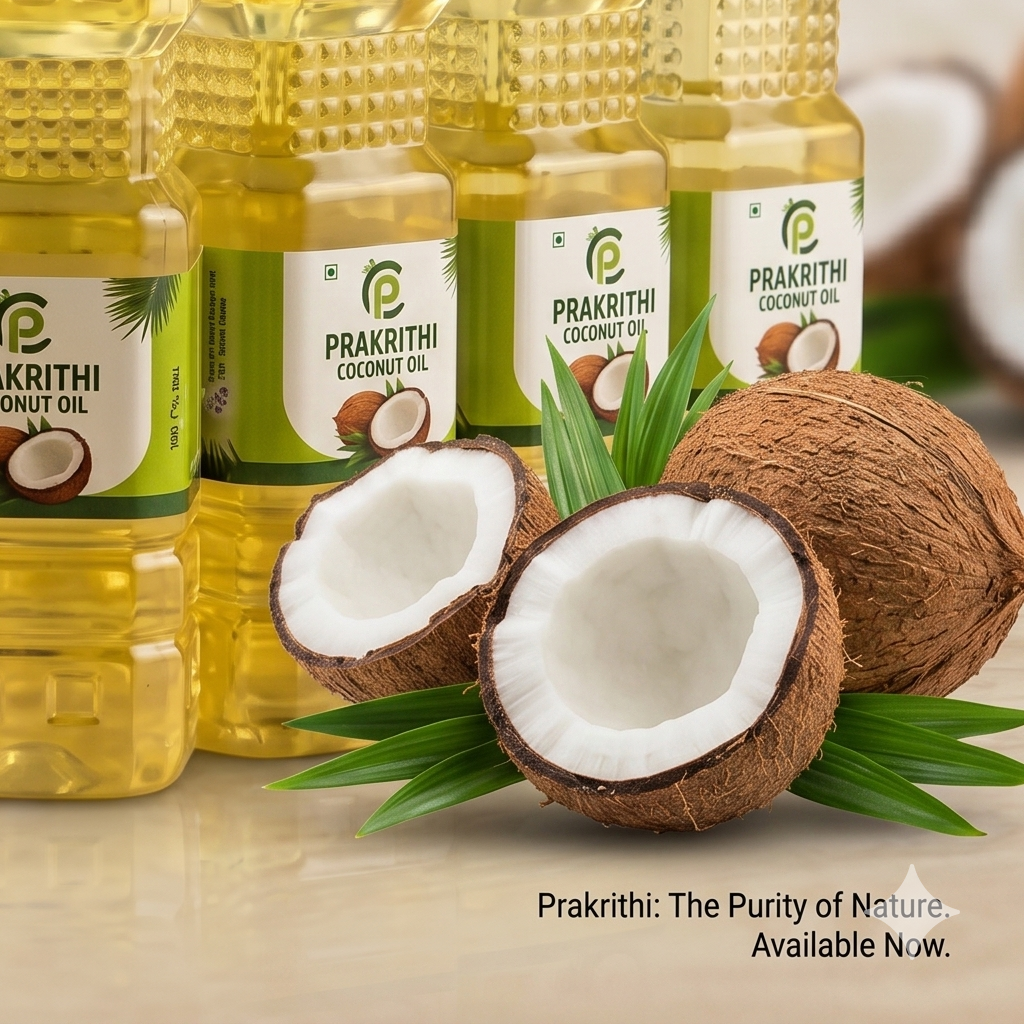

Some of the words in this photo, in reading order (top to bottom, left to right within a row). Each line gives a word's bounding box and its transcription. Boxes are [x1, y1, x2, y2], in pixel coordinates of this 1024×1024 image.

[749, 257, 847, 293] PRAKRITHI
[553, 287, 655, 325] PRAKRITHI
[759, 290, 818, 312] COCONUT
[820, 288, 840, 305] OIL
[325, 322, 437, 360] PRAKRITHI
[563, 324, 624, 345] COCONUT
[627, 319, 648, 336] OIL
[337, 357, 404, 381] COCONUT
[407, 354, 429, 373] OIL
[57, 395, 88, 414] OIL
